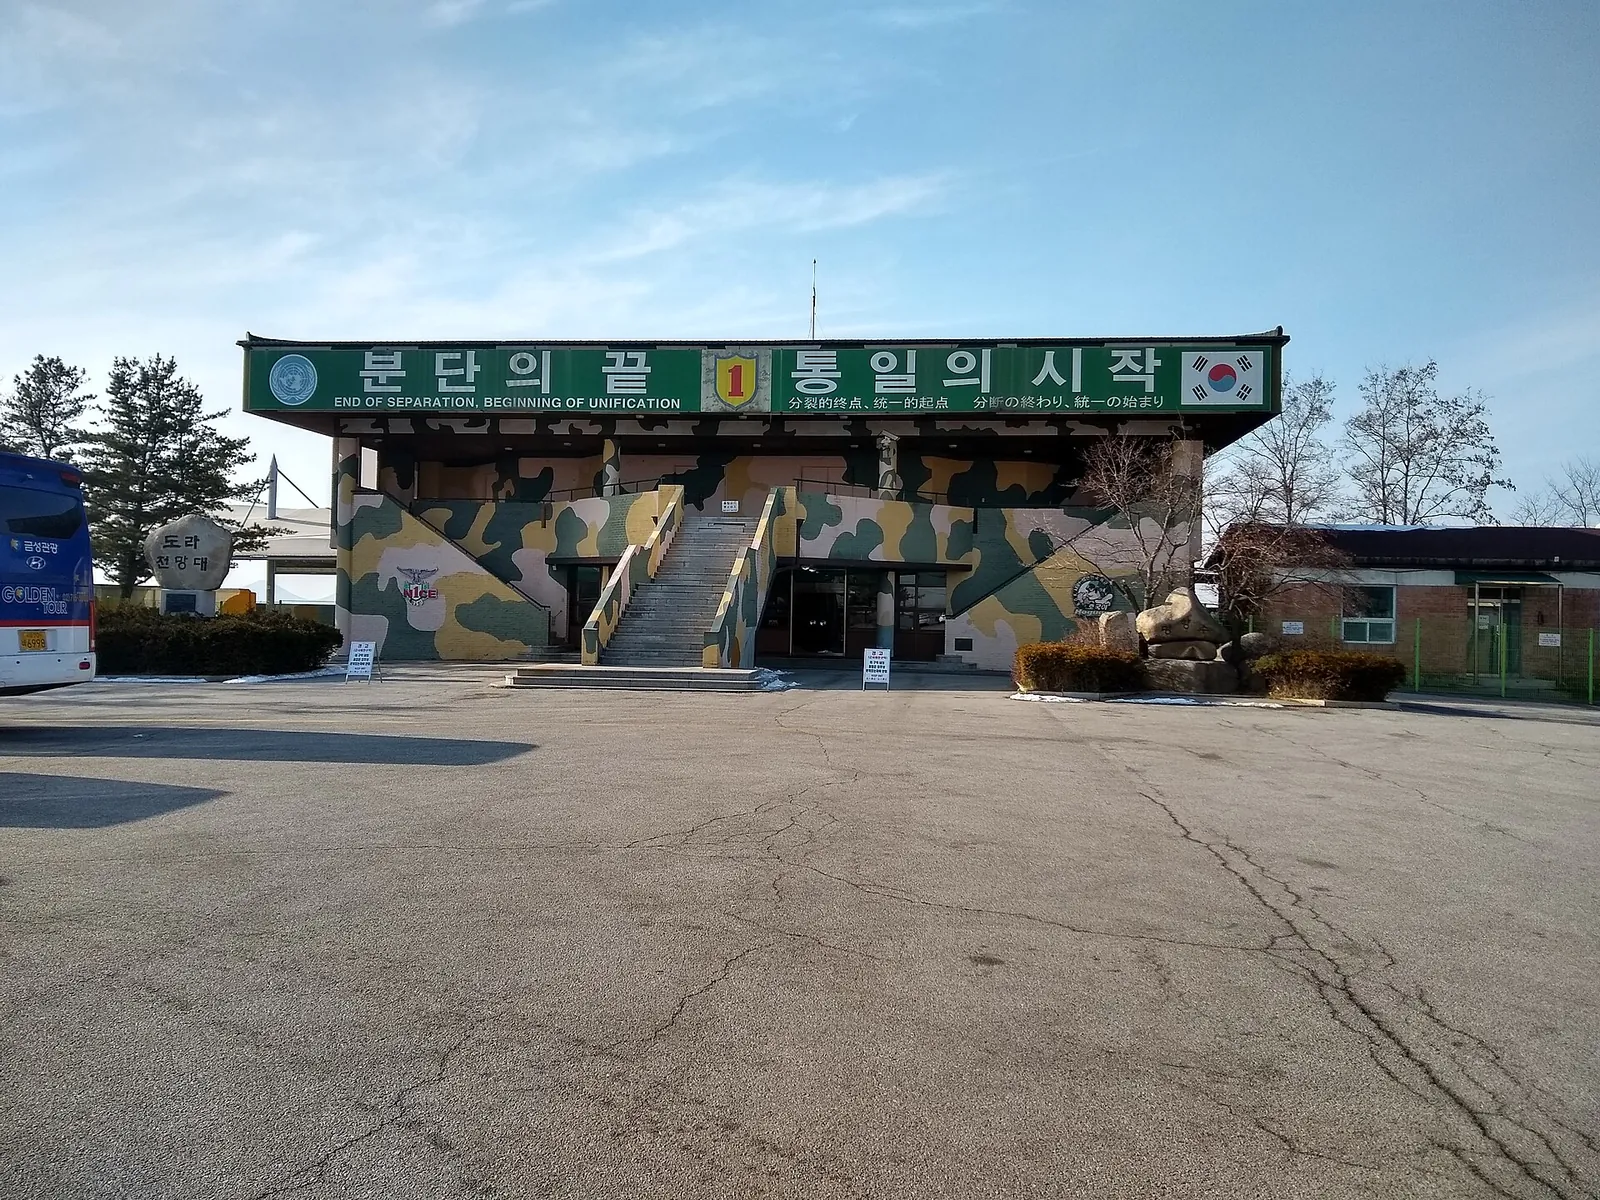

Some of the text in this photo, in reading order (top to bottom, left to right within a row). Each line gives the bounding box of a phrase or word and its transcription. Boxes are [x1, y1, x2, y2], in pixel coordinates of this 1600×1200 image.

[359, 350, 651, 394] 분단의 끝
[791, 348, 1162, 394] 통일의 시작
[727, 364, 744, 398] 1
[334, 397, 681, 409] END OF SEPARATION, BEGINNING OF UNIFICATION
[24, 540, 58, 554] 금성관광
[163, 535, 200, 549] 도라
[156, 555, 208, 571] 전망대
[1, 586, 56, 603] GOLDEN
[41, 601, 68, 614] TOUR
